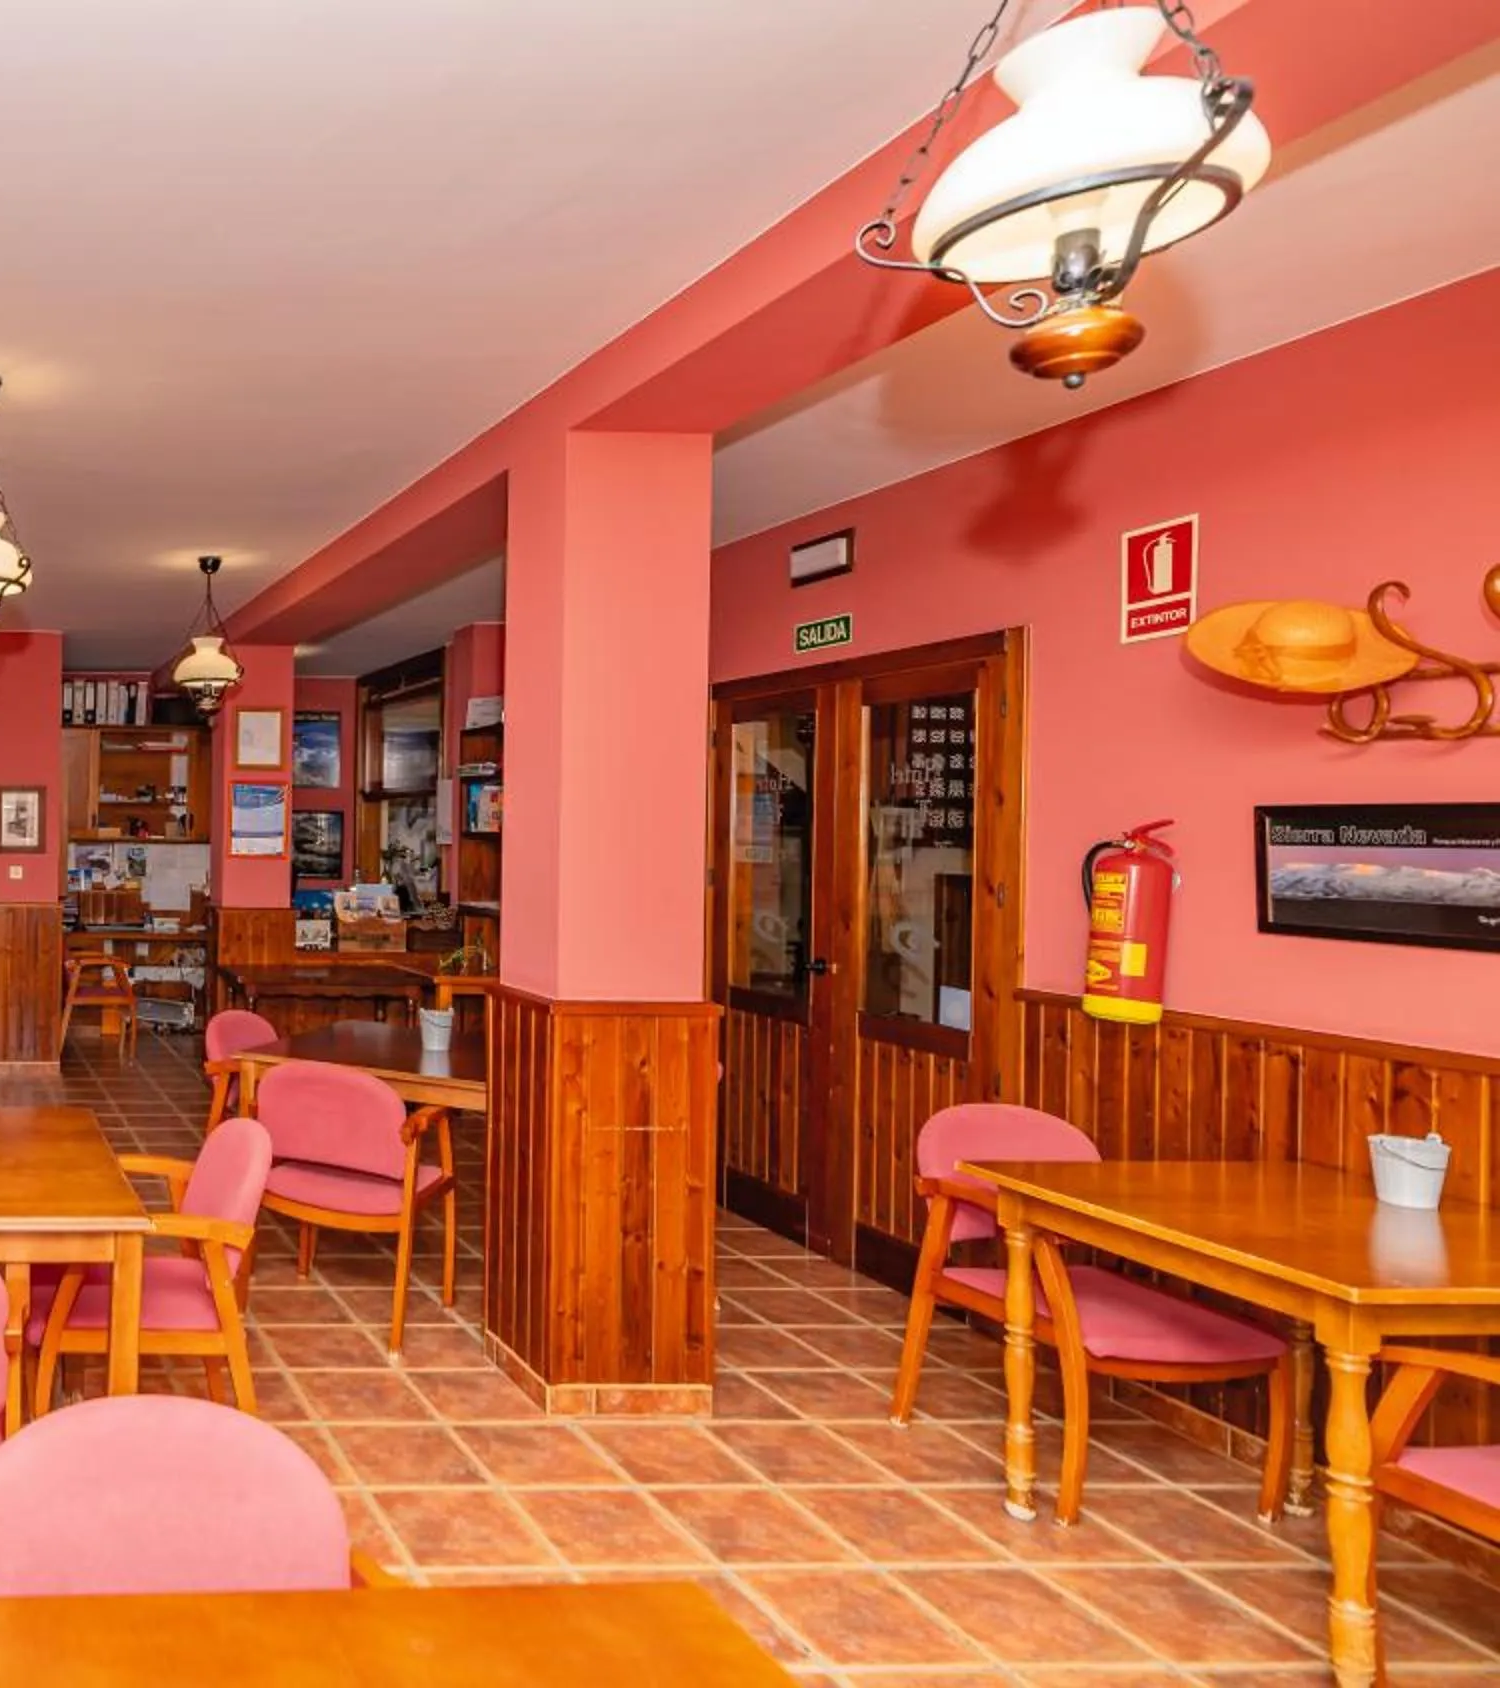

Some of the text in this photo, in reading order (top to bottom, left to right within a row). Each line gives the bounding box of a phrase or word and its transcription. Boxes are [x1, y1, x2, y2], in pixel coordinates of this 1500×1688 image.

[1130, 607, 1188, 629] EXTINTOR
[799, 620, 847, 648] SALIDA
[1271, 825, 1334, 844] Sierra
[1339, 825, 1427, 845] Nevada
